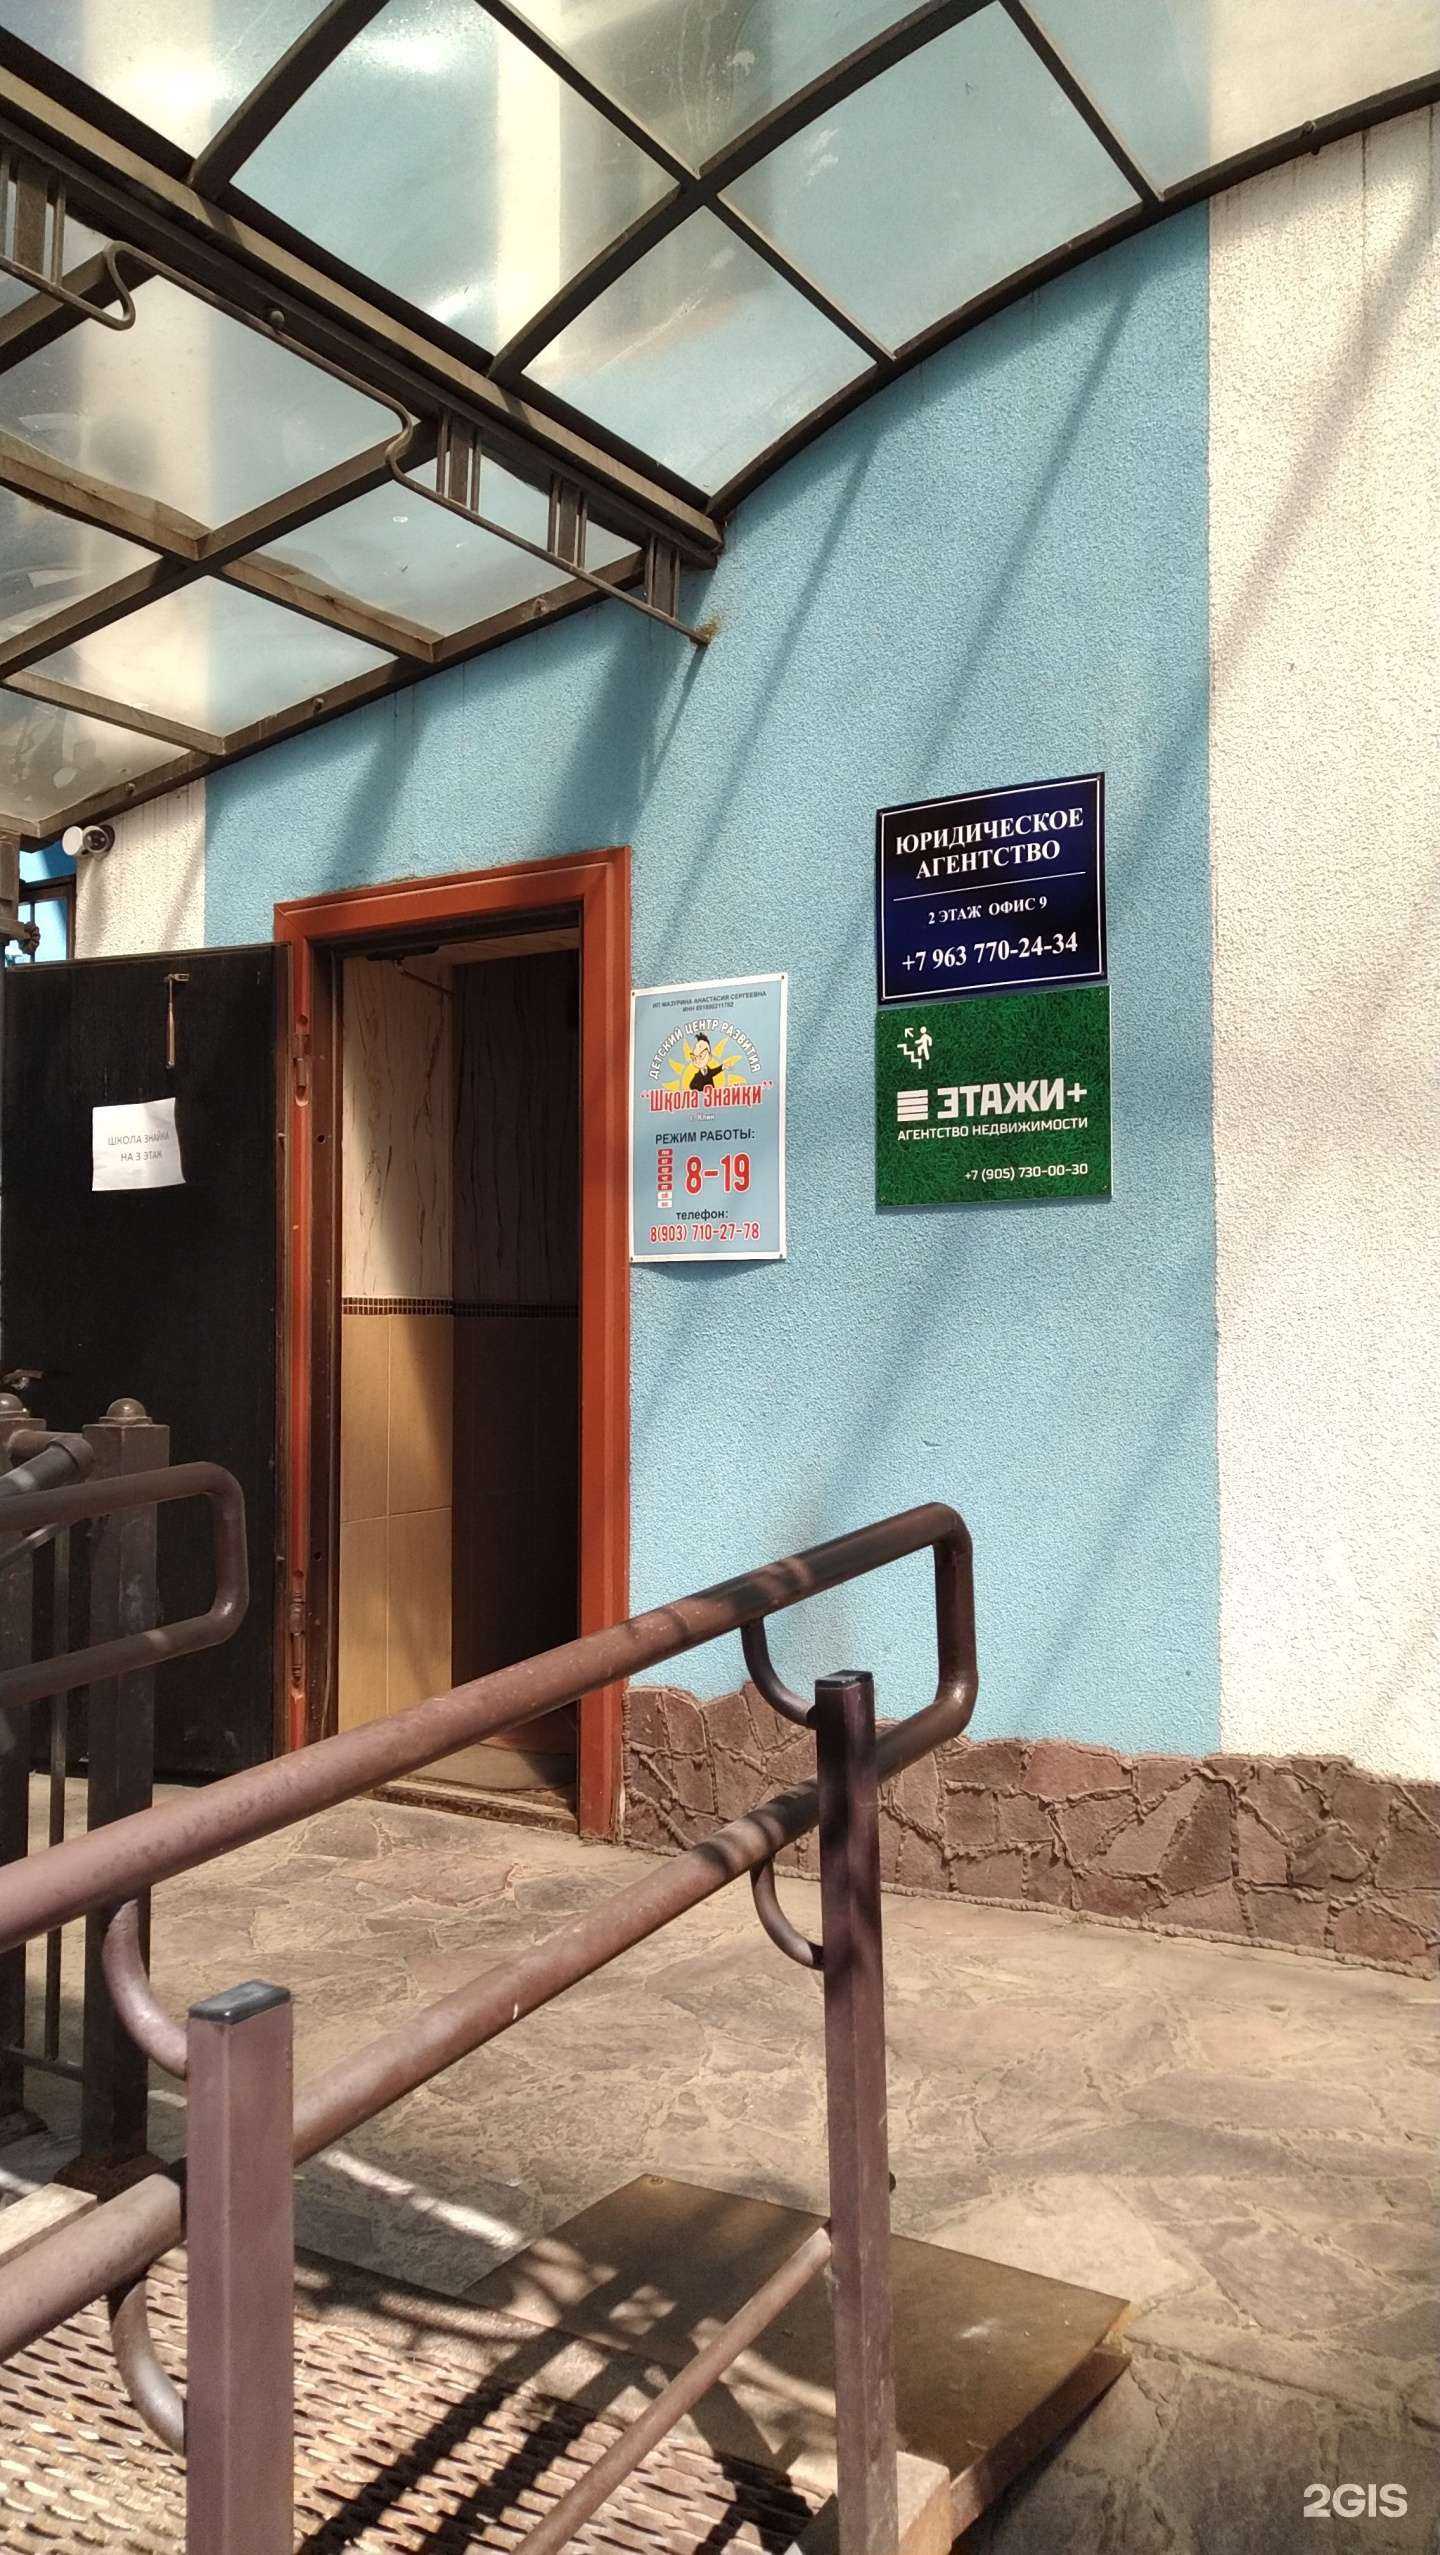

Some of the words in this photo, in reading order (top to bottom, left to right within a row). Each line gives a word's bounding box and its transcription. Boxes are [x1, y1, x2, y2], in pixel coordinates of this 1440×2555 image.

[896, 807, 1084, 855] ЮРИДИЧЕСКОЕ
[916, 840, 1061, 879] АГЕНТСТВО
[928, 912, 935, 925] 2
[939, 905, 982, 923] ЭТАЖ
[988, 897, 1035, 916] ОФИС
[1039, 896, 1048, 909] 9
[902, 951, 927, 972] +7
[932, 946, 967, 970] 963
[974, 931, 1078, 964] 770-24-34
[694, 995, 730, 1005] АНАСТАСИЯ
[730, 990, 767, 1000] СЕРГЕЕВНА
[649, 1027, 684, 1080] ДЕТСКИЙ
[685, 1019, 720, 1034] ЦЕНТР
[721, 1021, 761, 1073] РАЗВИТИЯ
[937, 1077, 1088, 1119] ЭТАЖИ+
[108, 1135, 142, 1146] ШКОЛА
[655, 1131, 697, 1145] РЕЖИМ
[700, 1128, 755, 1142] РАБОТЫ:
[897, 1126, 968, 1141] АГЕНТСТВО
[972, 1117, 1088, 1136] НЕДВИЖИМОСТИ
[121, 1152, 133, 1161] НА
[685, 1152, 751, 1196] 8-19
[964, 1170, 978, 1181] +7
[981, 1168, 1015, 1182] (905)
[1019, 1163, 1088, 1179] 730-00-30
[676, 1209, 728, 1221] телефон:
[649, 1224, 688, 1244] 8(903)
[691, 1221, 760, 1241] 710-27-78
